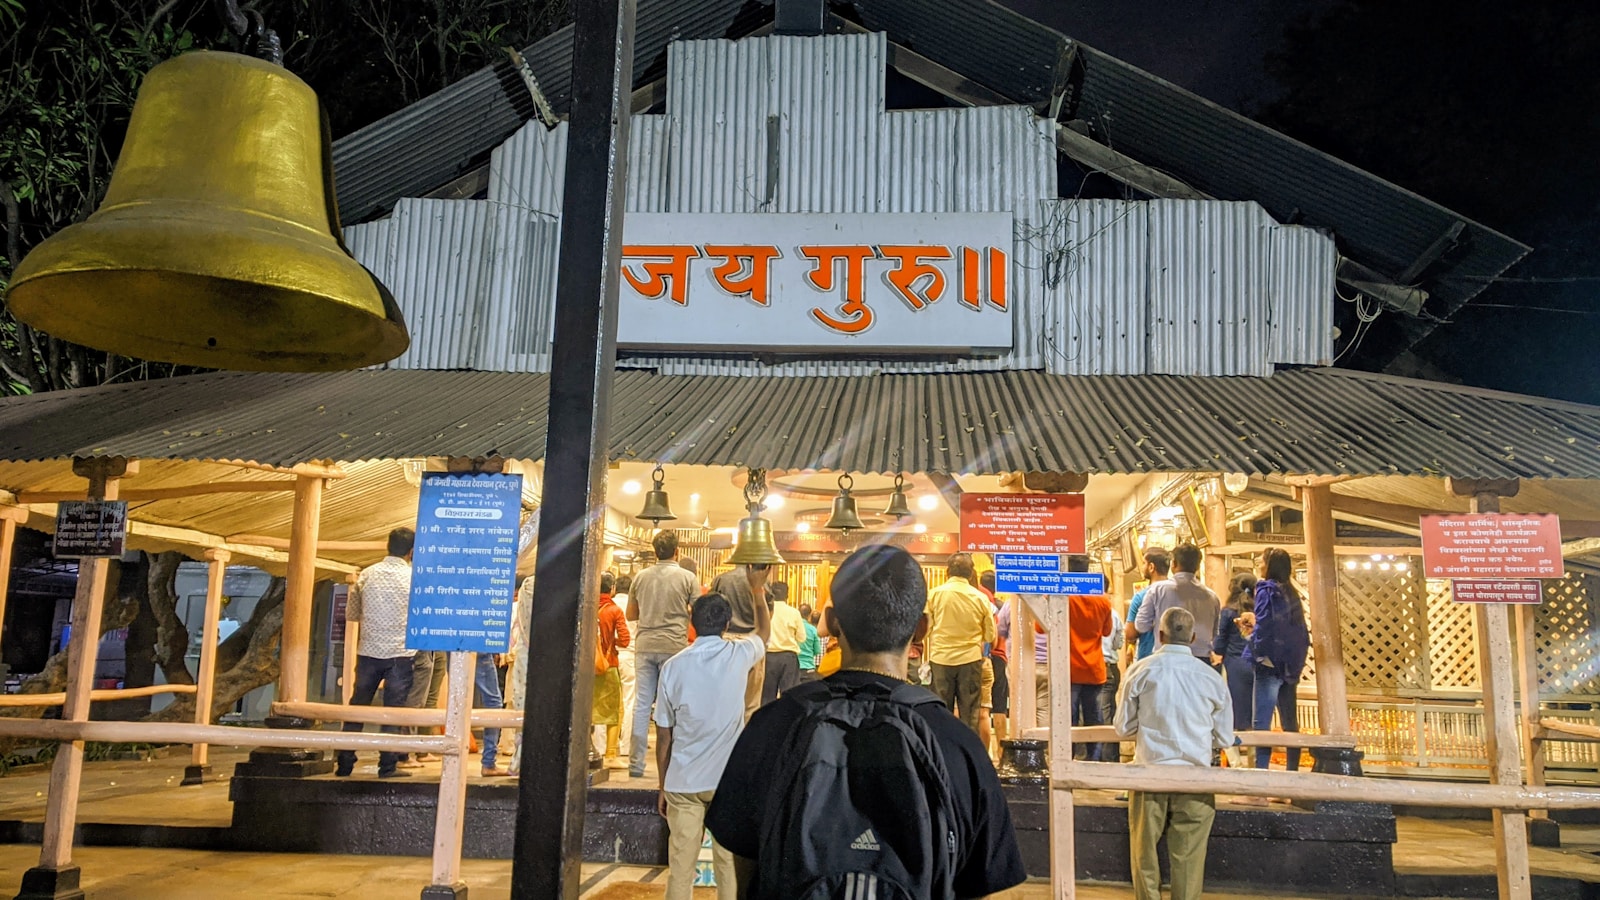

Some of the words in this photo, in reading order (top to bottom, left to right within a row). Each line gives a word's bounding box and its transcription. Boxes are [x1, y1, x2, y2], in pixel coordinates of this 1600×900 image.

[621, 244, 783, 307] जय
[428, 545, 436, 553] श्री
[502, 568, 511, 578] पुणे
[1022, 574, 1039, 582] मध्ये
[1041, 575, 1060, 583] फोटो
[424, 586, 434, 594] श्री
[1039, 584, 1058, 592] मनाई
[422, 607, 431, 615] श्री
[435, 607, 453, 615] समीर
[850, 842, 880, 851] adidas
